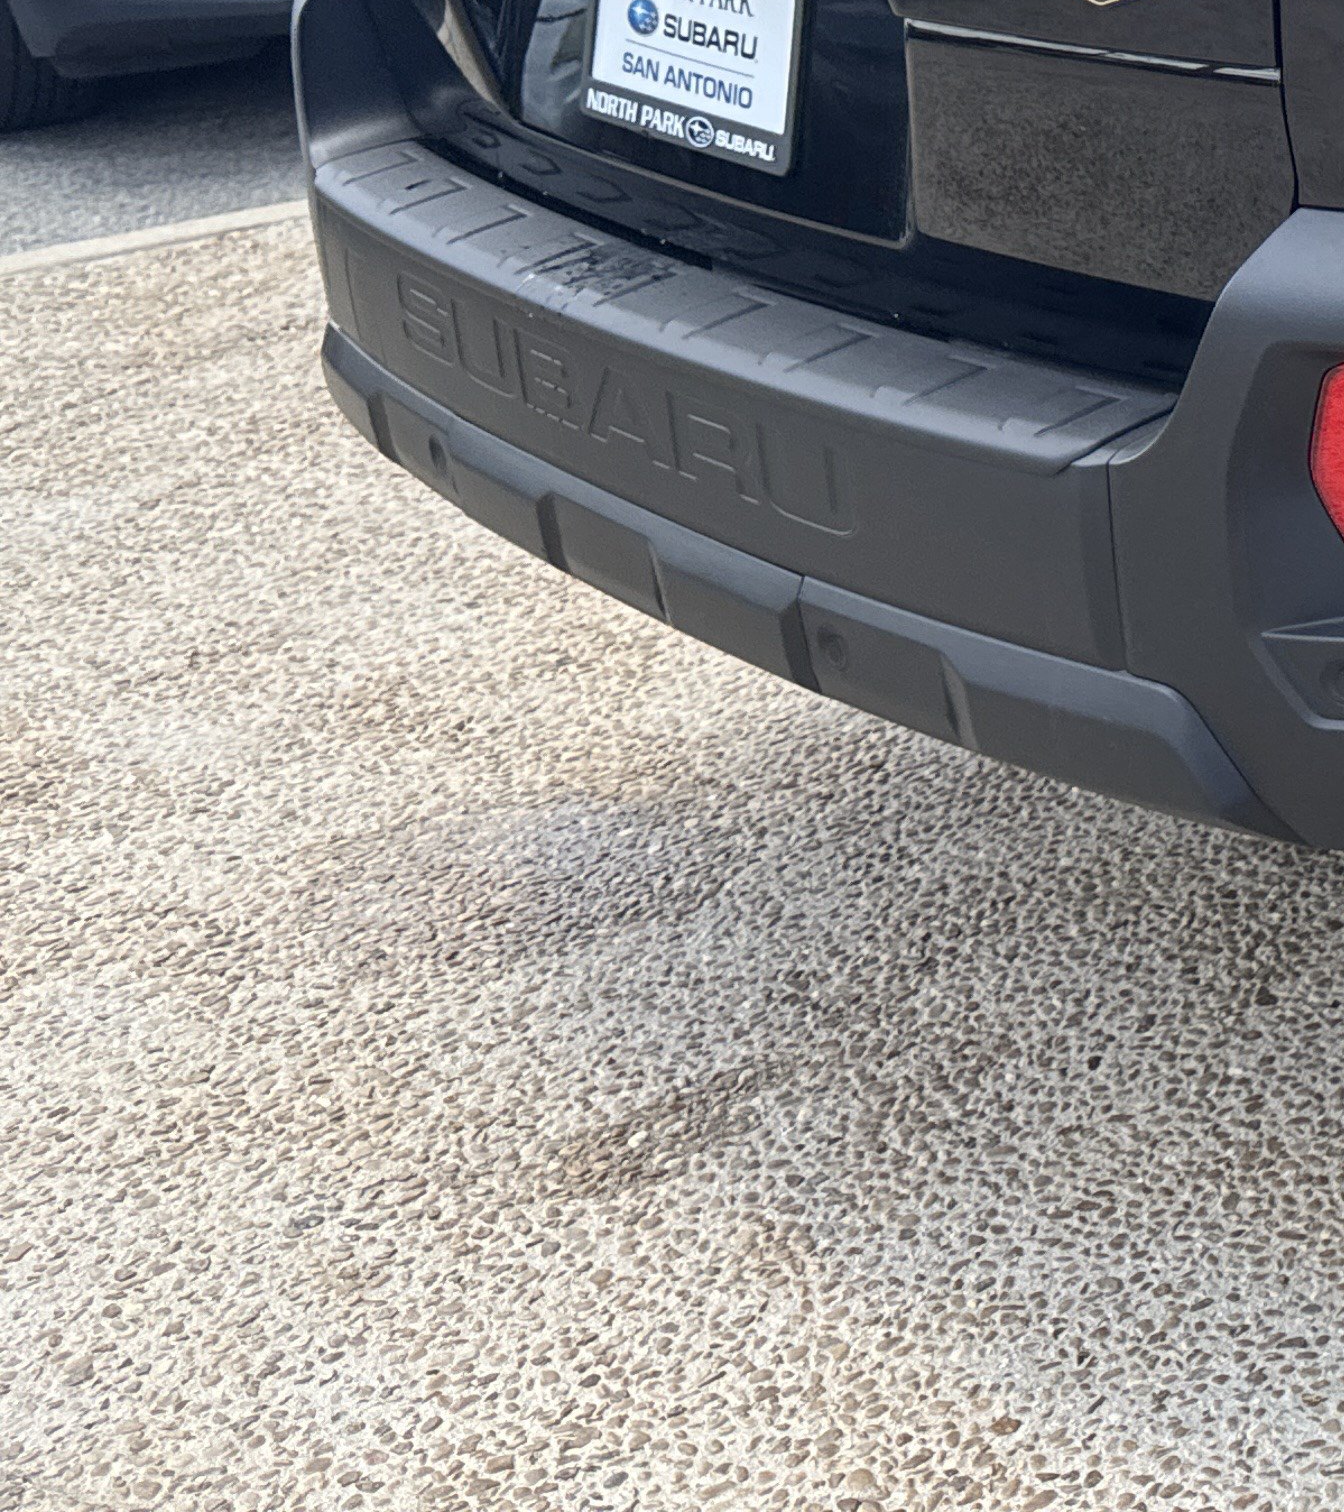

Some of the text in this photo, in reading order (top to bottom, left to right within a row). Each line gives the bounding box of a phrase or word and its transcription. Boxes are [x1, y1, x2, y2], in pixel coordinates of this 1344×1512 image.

[663, 13, 759, 60] SUBARU
[621, 51, 753, 109] SAN ANTONIO
[586, 87, 776, 161] NORTH PARK SUBARU
[397, 273, 857, 536] SUBARU
